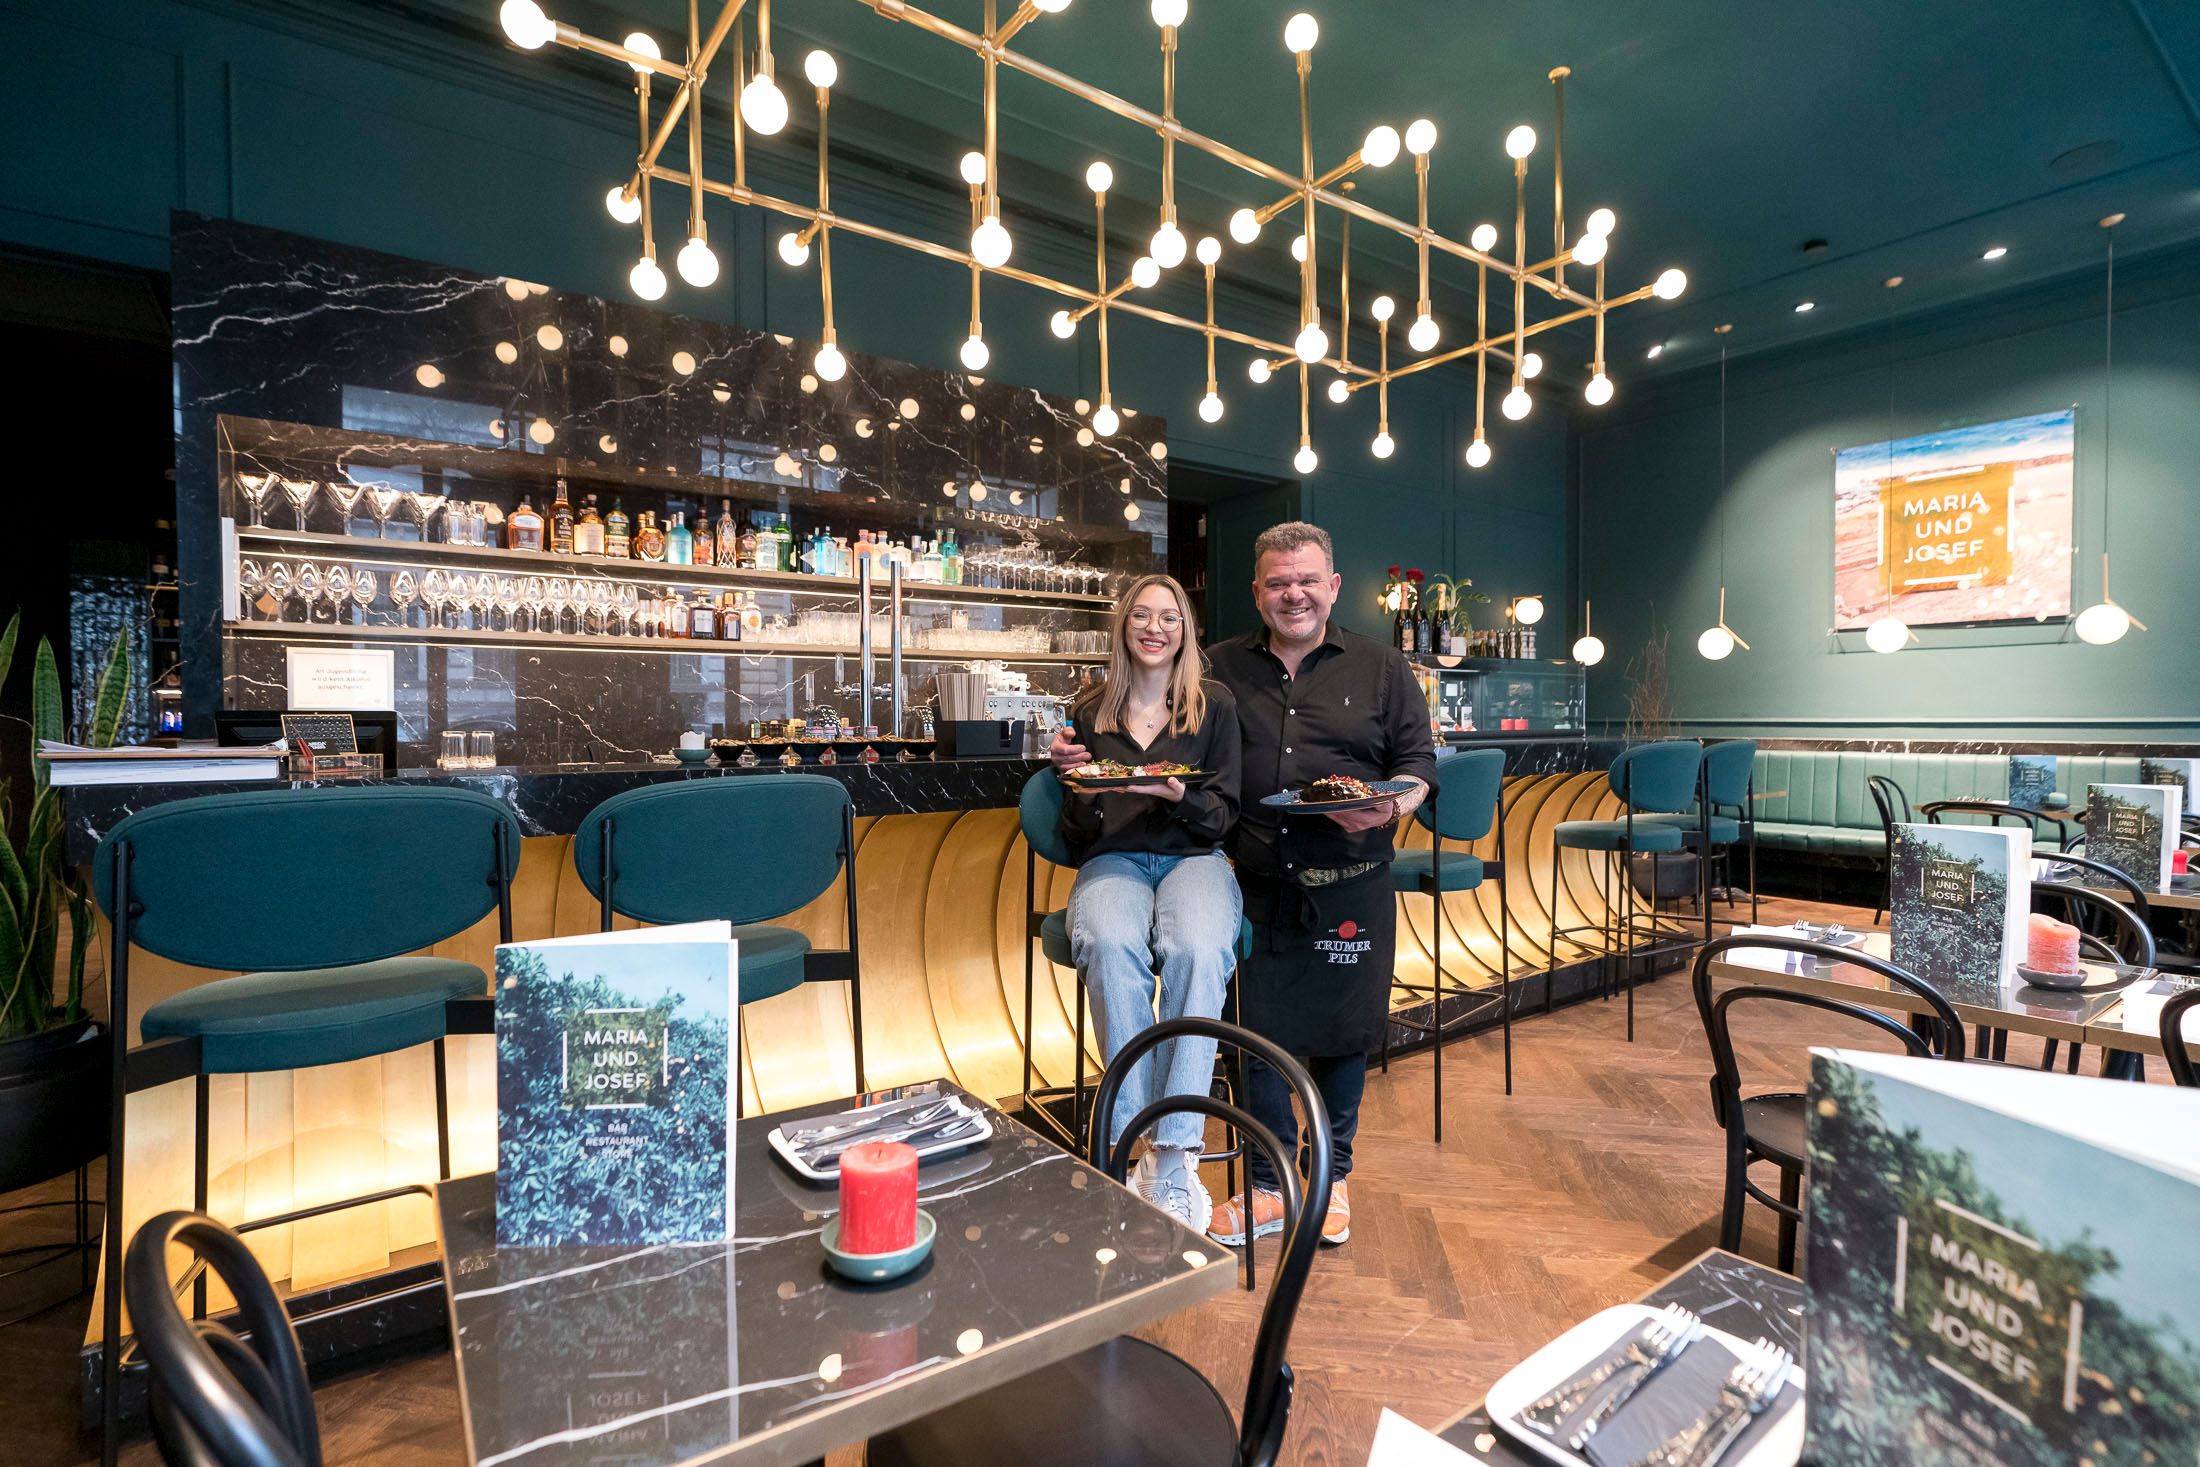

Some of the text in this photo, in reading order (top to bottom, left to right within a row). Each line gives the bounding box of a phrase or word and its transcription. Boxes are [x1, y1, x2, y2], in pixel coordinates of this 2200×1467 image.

[1903, 490, 1987, 517] MARIA
[1915, 518, 1973, 539] UND
[1903, 539, 1985, 564] JOSEF
[2115, 812, 2138, 820] MARIA
[2115, 826, 2137, 834] JOSEF
[1931, 869, 1964, 880] MARIA
[1936, 880, 1959, 890] UND
[1931, 891, 1964, 901] JOSEF
[1313, 940, 1371, 952] TRUMER
[1327, 952, 1358, 964] PILS
[583, 1029, 648, 1045] MARIA
[593, 1050, 638, 1067] UND
[584, 1073, 647, 1090] JOSEF
[607, 1123, 628, 1134] BAR
[585, 1135, 649, 1147] RESTAURANT
[1930, 1233, 2043, 1311] MARIA
[1944, 1276, 2023, 1338] UND
[1929, 1308, 2036, 1382] JOSEF
